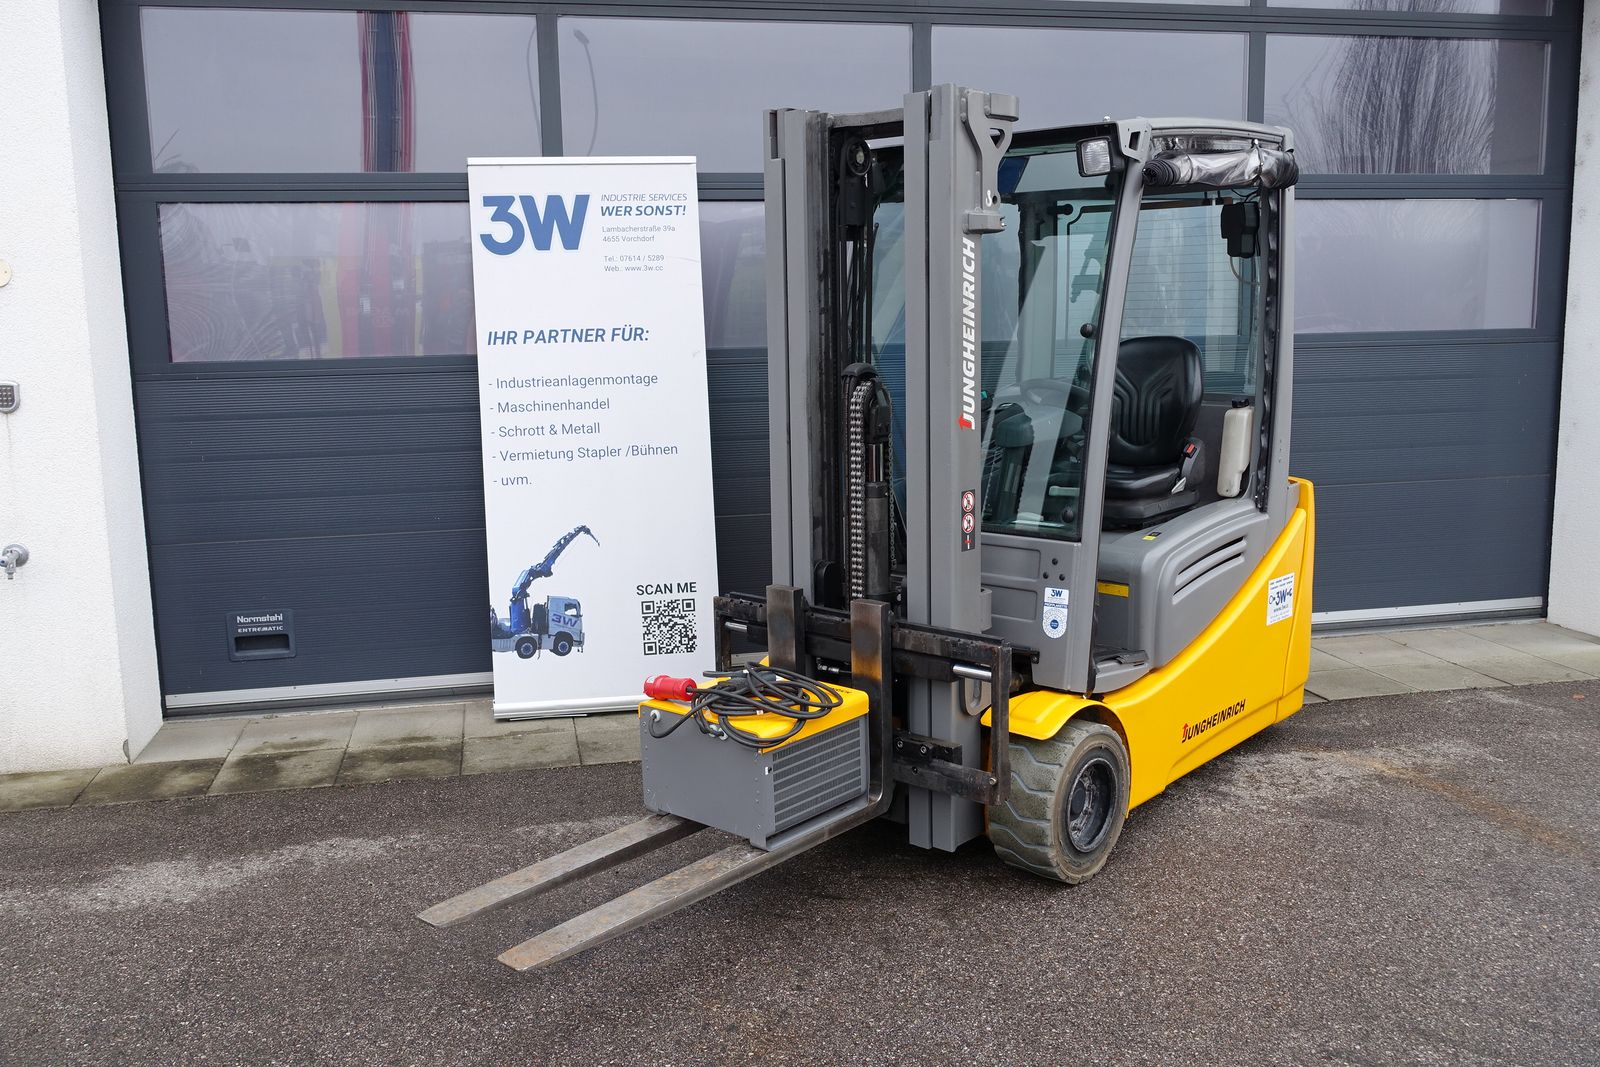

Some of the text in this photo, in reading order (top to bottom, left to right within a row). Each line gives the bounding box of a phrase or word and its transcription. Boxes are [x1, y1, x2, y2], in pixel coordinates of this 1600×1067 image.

[601, 193, 687, 202] INDUSTRIE SERVICES
[601, 205, 686, 217] WER SONST!
[480, 194, 590, 256] 3W
[602, 225, 661, 233] Lambacherstraße
[647, 254, 665, 262] 5289
[624, 264, 664, 272] www.3w.cc
[487, 324, 650, 346] IHR PARTNER FÜR:
[961, 237, 976, 431] JUNGHEINRICH
[496, 374, 658, 389] Industrieanlagenmontage
[497, 398, 610, 413] Maschinenhandel
[498, 425, 545, 438] Schrott
[549, 424, 558, 436] &
[561, 422, 600, 435] Metall
[499, 448, 574, 462] Vermietung
[577, 446, 622, 460] Stapler
[501, 475, 532, 486] uvm.
[636, 582, 697, 596] SCAN ME
[1051, 589, 1063, 598] 3W
[237, 614, 283, 623] Normstahl
[551, 613, 578, 628] 3W
[1181, 698, 1246, 744] JUNGHEINRICH
